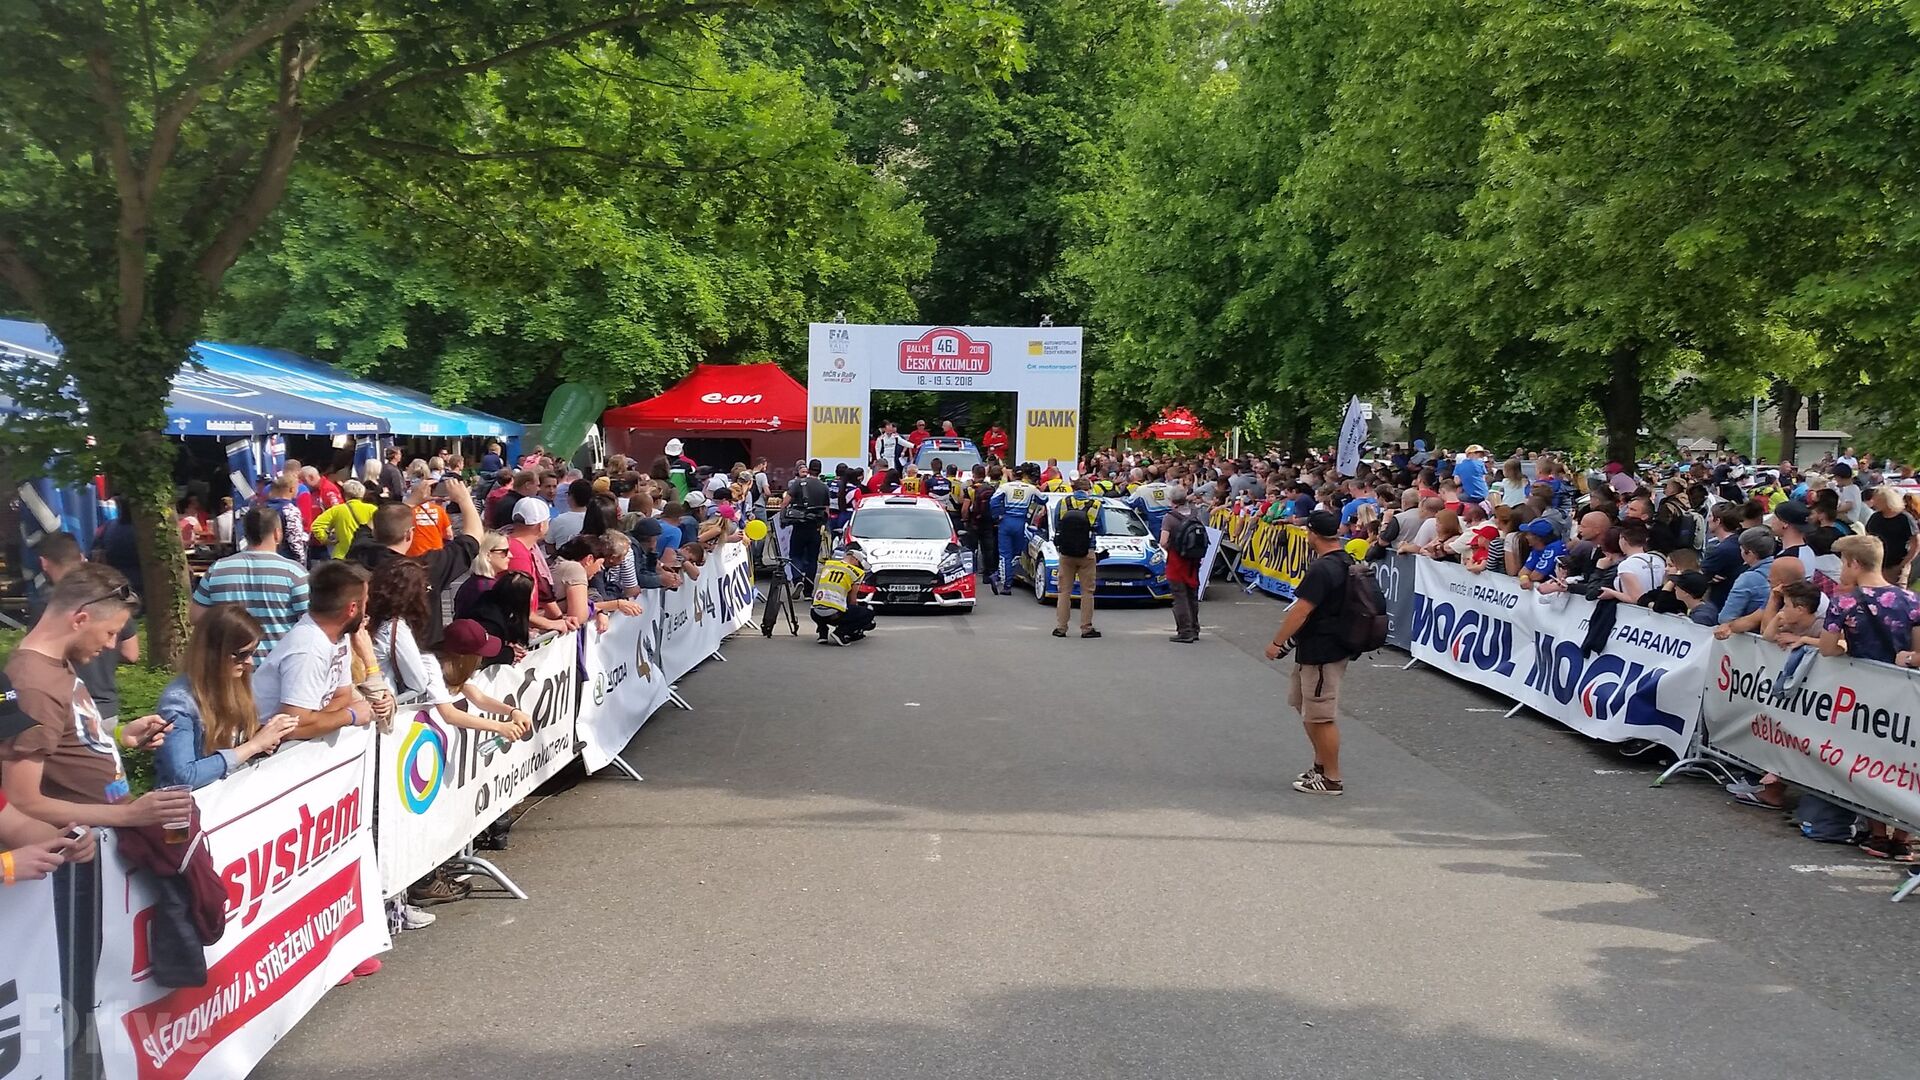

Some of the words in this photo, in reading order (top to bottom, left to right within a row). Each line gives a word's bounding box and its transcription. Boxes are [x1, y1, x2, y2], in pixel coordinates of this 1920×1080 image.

[906, 345, 931, 353] RALLYE
[968, 346, 985, 354] 2018
[937, 340, 956, 353] 46.
[906, 356, 937, 370] ČESKÝ
[939, 358, 984, 371] KRUMLOV
[917, 375, 928, 386] 18.
[934, 375, 944, 386] 19.
[945, 376, 953, 386] 5.
[954, 376, 973, 386] 2018
[813, 407, 860, 425] UAMK
[1027, 410, 1075, 427] UAMK
[829, 570, 845, 583] 117
[1449, 581, 1466, 596] made
[1466, 586, 1473, 597] in
[1473, 585, 1519, 609] PARAMO
[1412, 592, 1517, 677] MOGUL
[1616, 625, 1692, 659] PARAMO
[1751, 712, 1811, 756] děláme
[1820, 739, 1844, 767] to
[493, 764, 519, 802] Tvoje
[519, 734, 569, 782] autokamera
[220, 786, 362, 929] system
[142, 972, 240, 1069] SLEDOVÁNÍ
[243, 970, 256, 1003] A
[255, 914, 316, 992] STŘEŽENÍ
